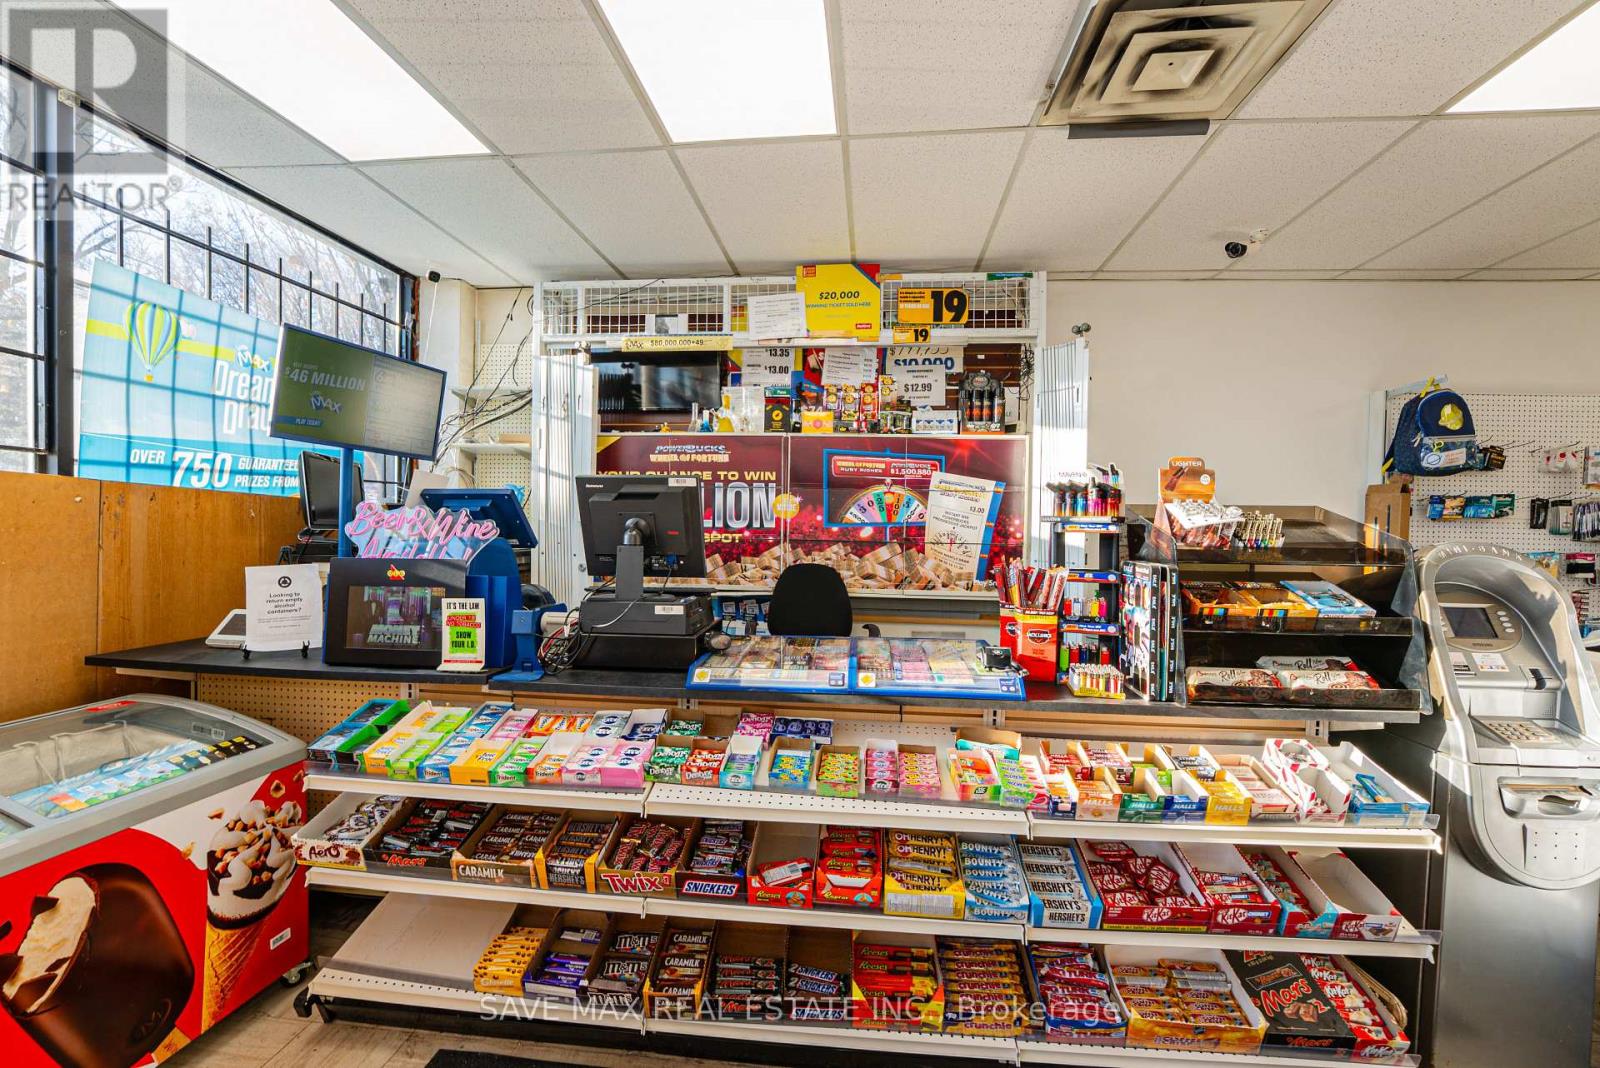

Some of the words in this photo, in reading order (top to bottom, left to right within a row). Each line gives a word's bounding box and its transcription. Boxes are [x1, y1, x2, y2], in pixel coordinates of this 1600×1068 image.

[819, 290, 860, 301] $20,000
[930, 289, 968, 322] 19
[913, 328, 929, 342] 19
[765, 348, 790, 357] $13.35
[764, 365, 789, 374] $13.00
[311, 371, 367, 392] MILLION
[903, 382, 932, 393] $12.99
[649, 453, 678, 463] WHEEL
[130, 448, 166, 465] OVER
[172, 450, 233, 488] 750
[234, 474, 270, 488] PRIZES
[272, 475, 299, 488] FROM
[716, 471, 739, 480] TO
[744, 471, 777, 480] WIN
[701, 482, 777, 529] LION
[347, 501, 405, 537] Beer
[406, 505, 431, 538] &
[427, 507, 500, 546] Wine
[456, 631, 472, 639] SHOW
[451, 640, 465, 648] YOUR
[1295, 658, 1313, 670] Roll
[1218, 668, 1237, 682] Roll
[1315, 670, 1332, 682] Roll
[424, 769, 444, 778] Trident
[495, 773, 516, 781] Trident
[535, 770, 555, 778] Trident
[1214, 804, 1245, 812] HALLS
[525, 834, 547, 843] CARAM
[909, 833, 944, 846] HENRY!
[912, 846, 947, 859] HENRY!
[961, 842, 1001, 854] BOUNTY
[1022, 845, 1062, 857] HERSHEY'S
[387, 853, 427, 867] Mars
[964, 857, 1003, 868] BOUNTY
[458, 864, 504, 879] CARAMILK
[966, 869, 1008, 879] BOUNTY
[1026, 862, 1067, 875] HERSHEY'S
[549, 874, 585, 885] HERSHEY'S
[601, 872, 663, 894] Twix
[904, 872, 941, 886] HENRY!
[684, 881, 736, 896] SNICKERS
[1031, 880, 1074, 894] HERSHEY'S
[974, 908, 1011, 917] BOUNTY
[1049, 911, 1086, 923] HERSHEY'S
[1142, 907, 1172, 922] KitKat
[1217, 908, 1248, 925] KitKat
[673, 933, 707, 944] CARAMILK
[664, 957, 701, 968] CARAMILK
[798, 965, 838, 982] SNICKERS
[1311, 968, 1338, 981] KitKat
[662, 986, 694, 996] CARAMI
[799, 979, 838, 995] SNICKERS
[1325, 983, 1351, 998] KitKat
[1260, 978, 1313, 1018] Mars
[1314, 999, 1326, 1013] 2
